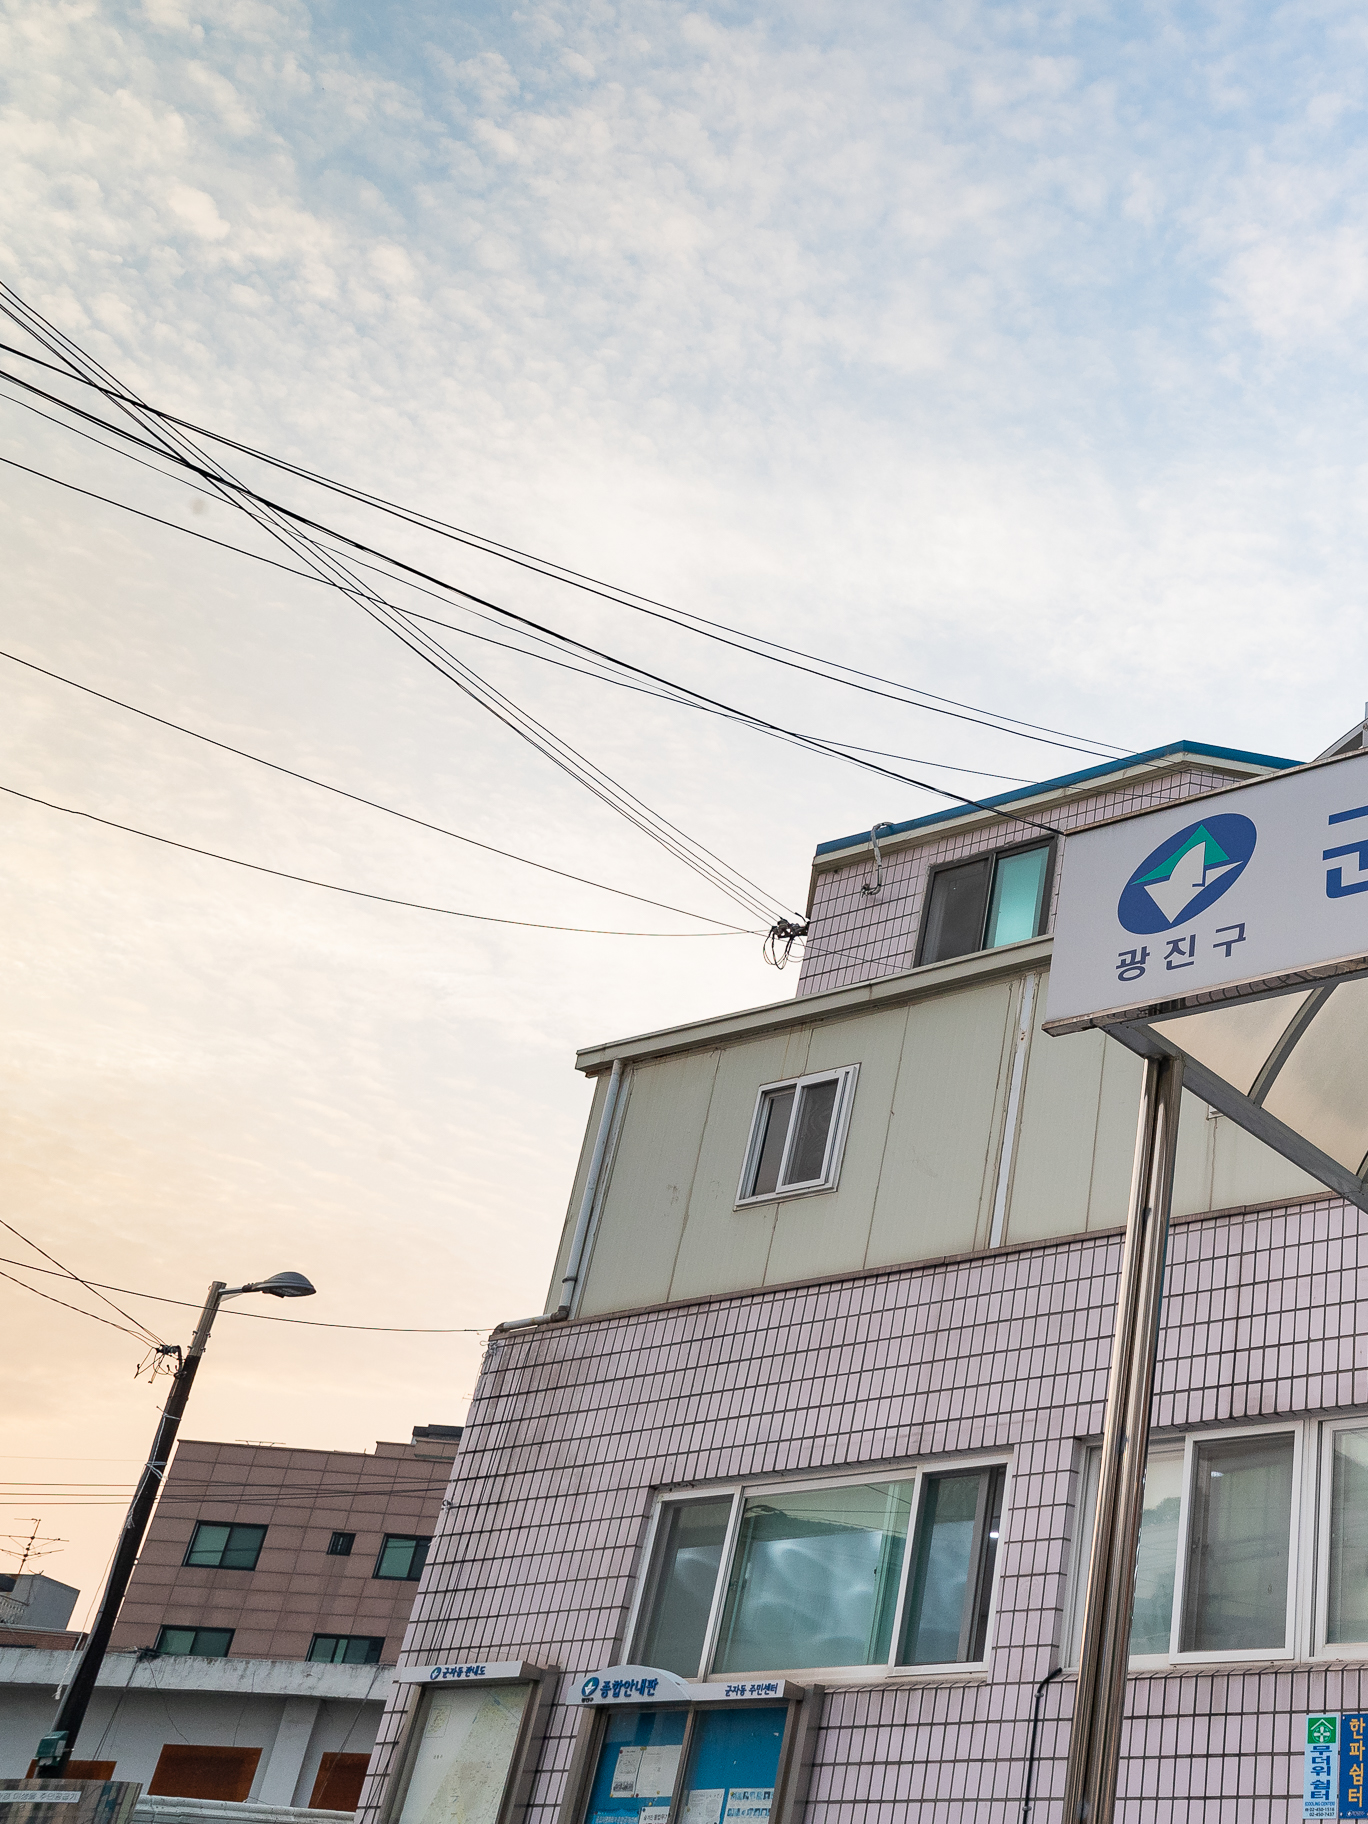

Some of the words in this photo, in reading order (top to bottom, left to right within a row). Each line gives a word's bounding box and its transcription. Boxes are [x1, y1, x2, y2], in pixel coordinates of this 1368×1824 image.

[1116, 922, 1247, 982] 광진구
[442, 1666, 464, 1678] 군자동
[600, 1678, 659, 1698] 종합안내판
[724, 1684, 747, 1697] 군자동
[748, 1682, 779, 1696] 주민센터
